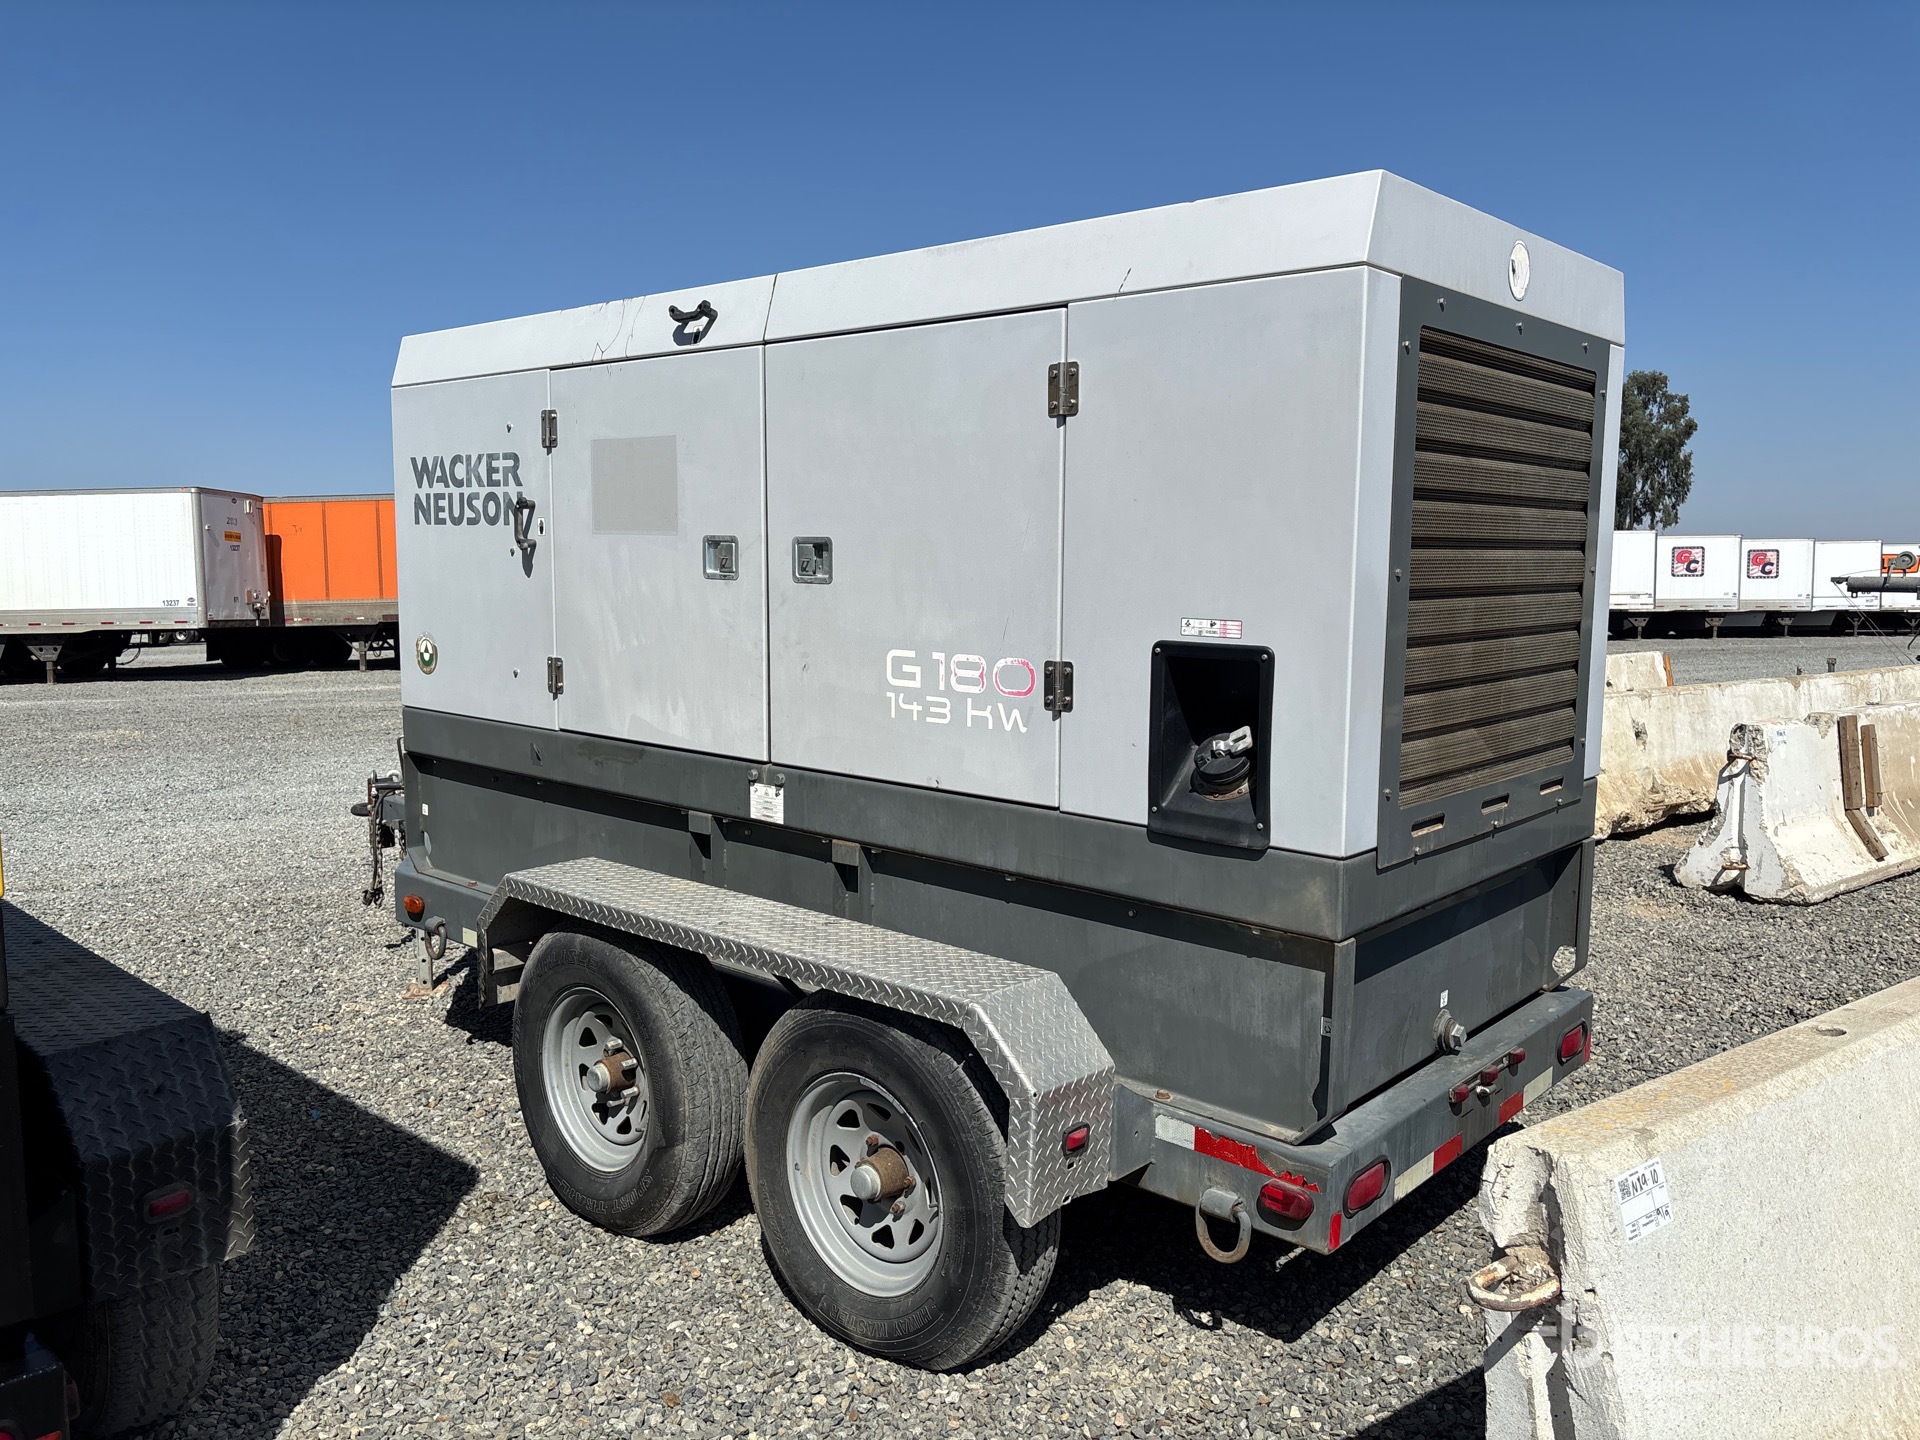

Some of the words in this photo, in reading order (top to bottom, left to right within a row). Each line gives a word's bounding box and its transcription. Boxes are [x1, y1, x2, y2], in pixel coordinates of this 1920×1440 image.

[410, 452, 523, 488] WACKER
[414, 491, 523, 526] NEUSON
[162, 599, 180, 607] 13237
[886, 649, 922, 689] G
[932, 651, 1037, 699] 180
[886, 691, 951, 725] 143
[557, 1177, 607, 1215] TRAIL
[612, 1174, 654, 1215] SPORT
[829, 1304, 889, 1338] MASTER
